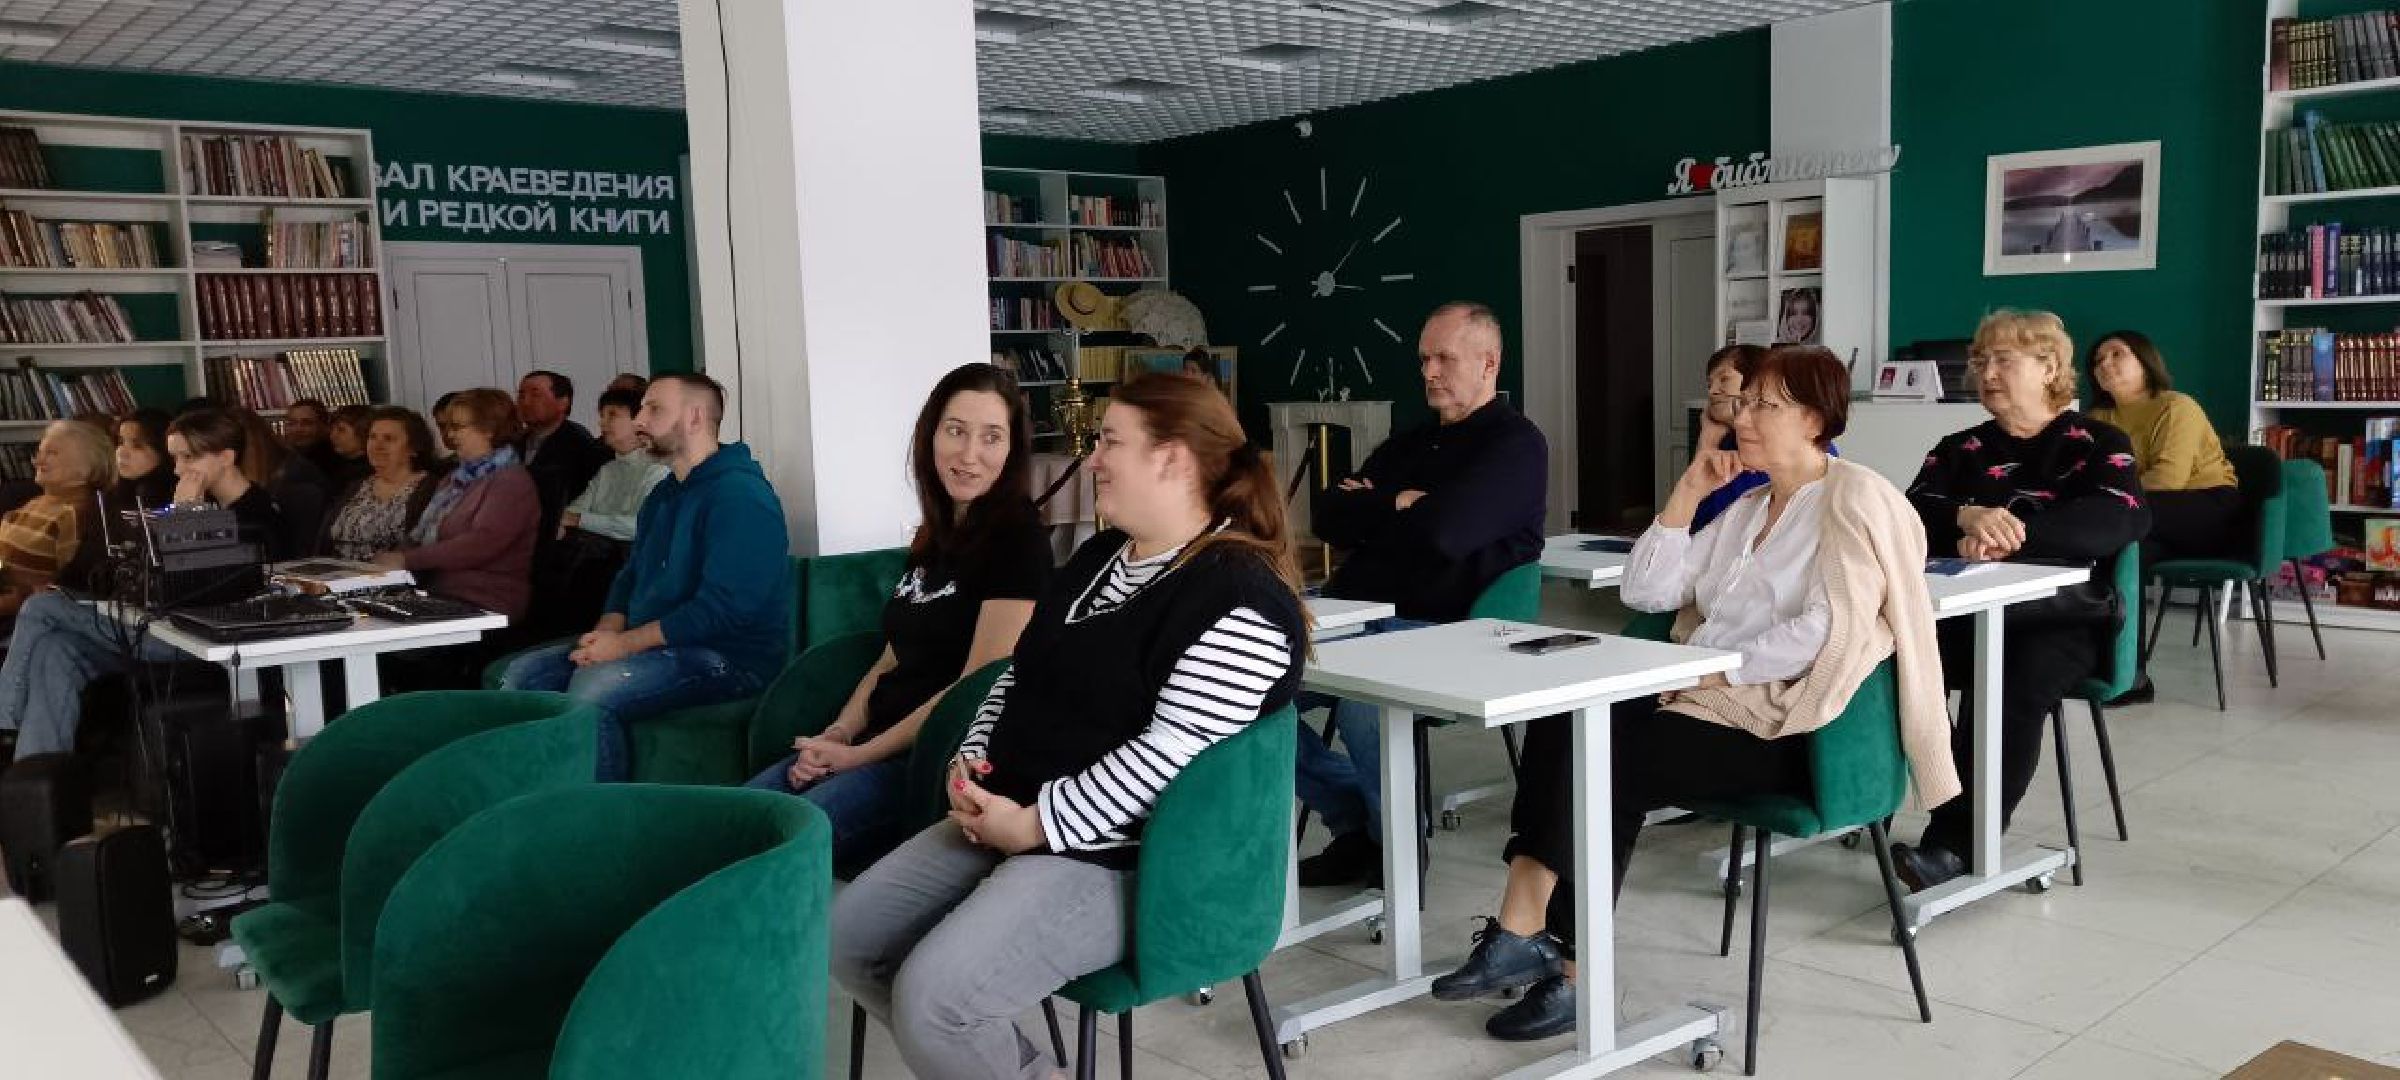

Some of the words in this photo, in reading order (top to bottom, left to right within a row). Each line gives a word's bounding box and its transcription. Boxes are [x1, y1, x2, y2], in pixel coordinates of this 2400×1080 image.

[448, 165, 675, 201] КРАЕВЕДЕНИЯ
[1667, 157, 1696, 195] Я
[383, 200, 409, 228] И
[419, 200, 556, 235] РЕДКОЙ
[570, 207, 670, 235] КНИГИ
